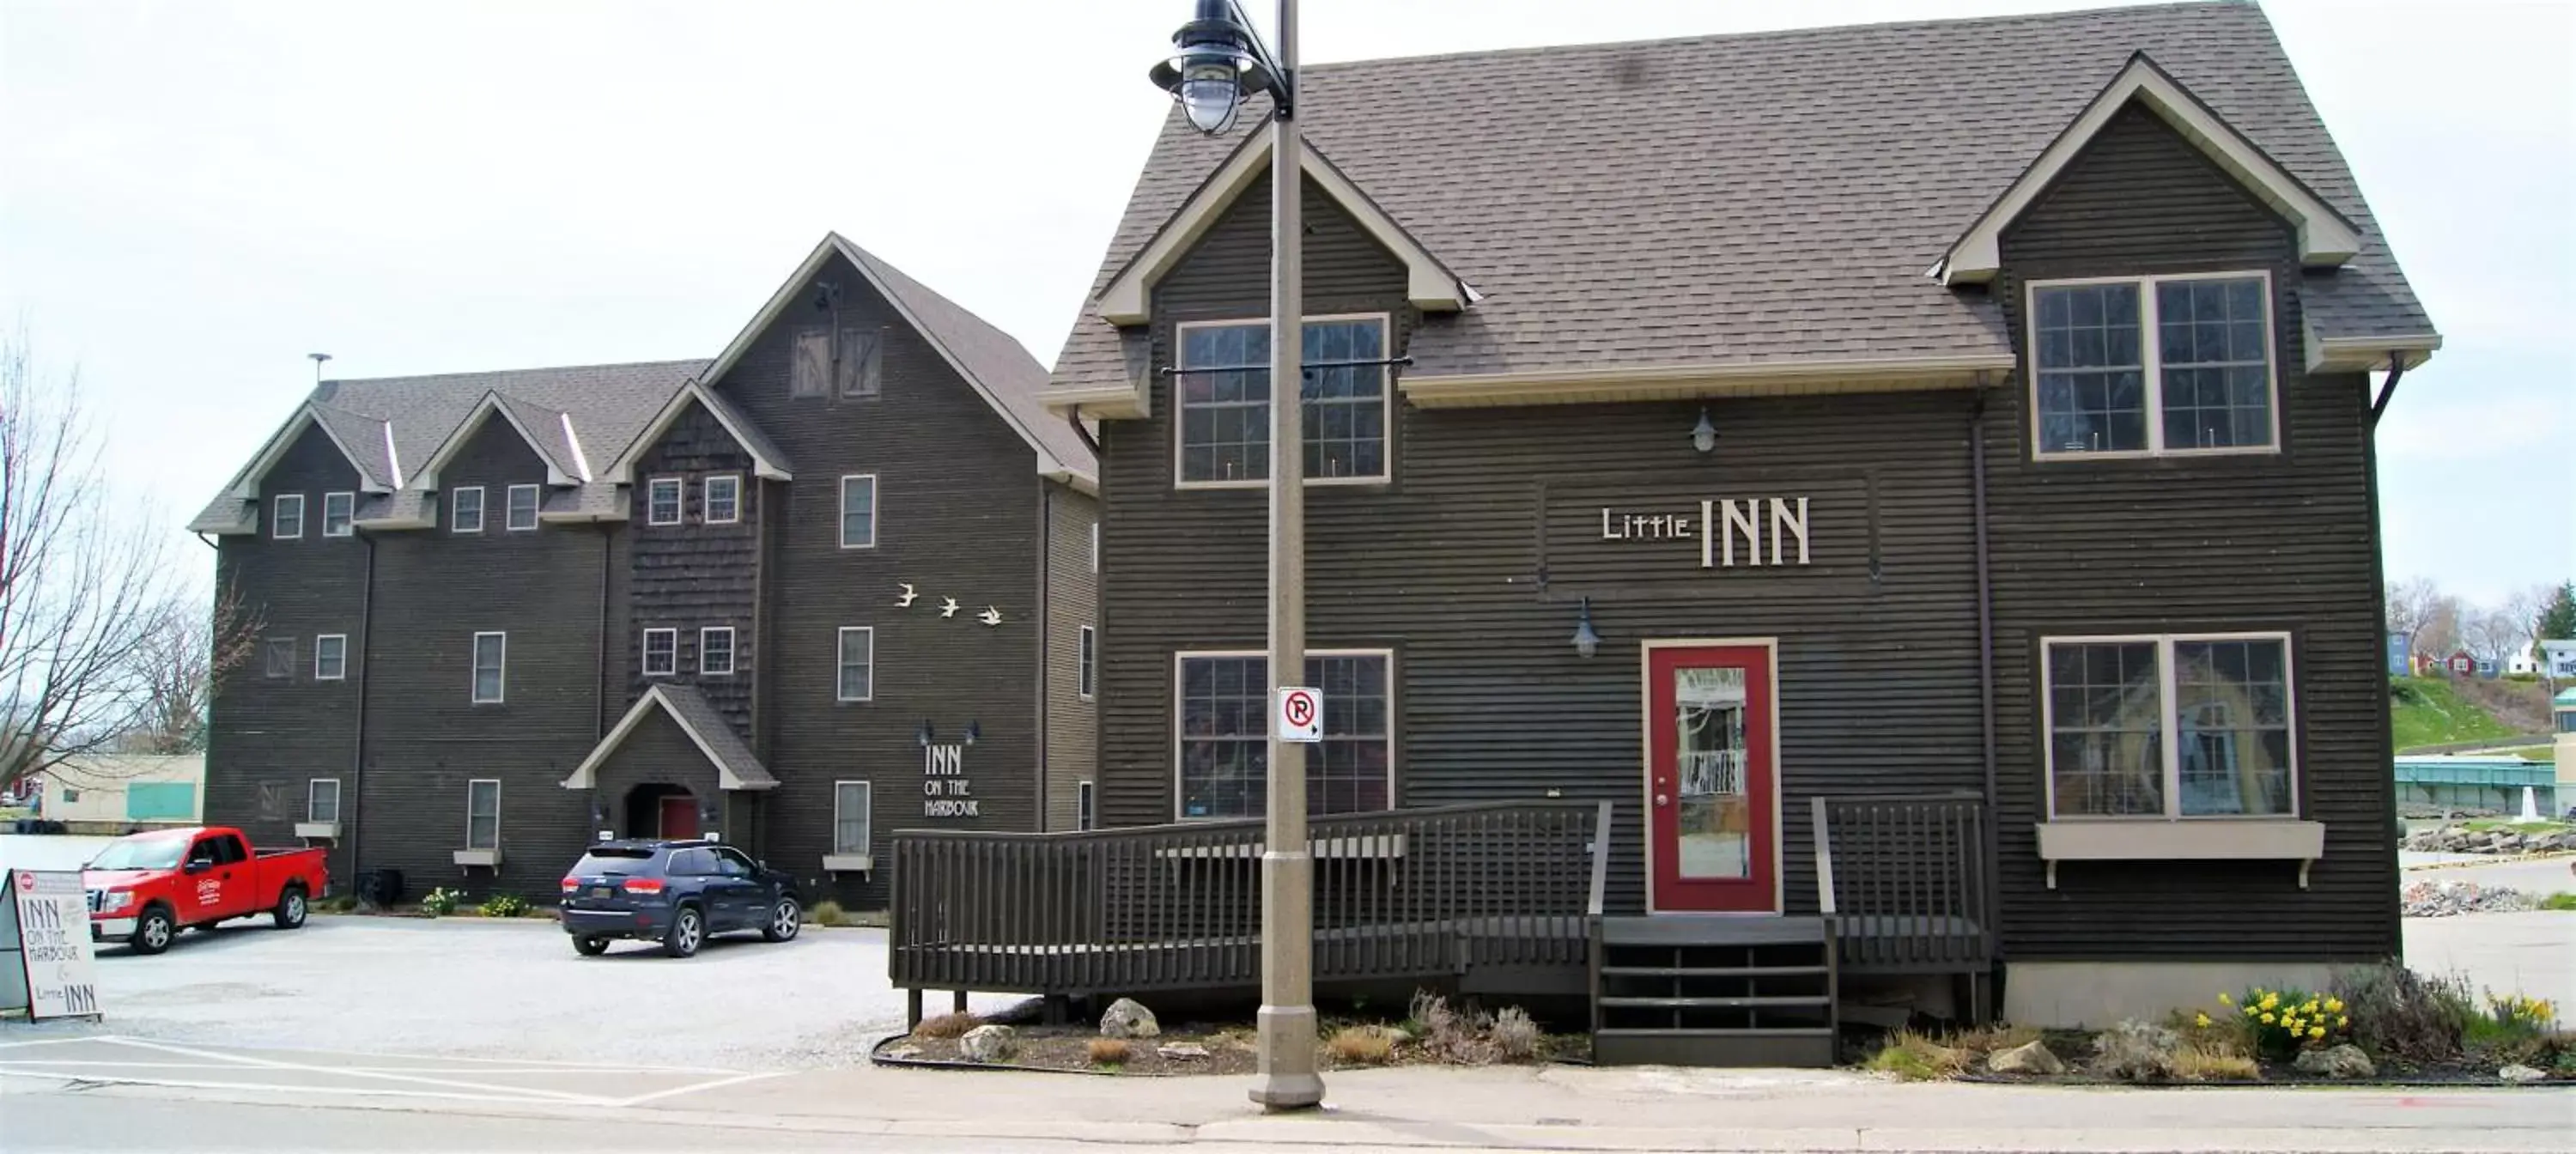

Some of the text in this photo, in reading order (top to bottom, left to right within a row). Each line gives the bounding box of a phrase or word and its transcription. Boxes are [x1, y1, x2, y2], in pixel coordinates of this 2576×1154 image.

[1701, 497, 1810, 568] INN
[925, 744, 962, 774] INN
[924, 779, 970, 796] ON THE
[924, 799, 979, 817] HARBOUR
[21, 899, 61, 929] INN
[26, 930, 70, 945] ON THE
[64, 983, 97, 1012] INN
